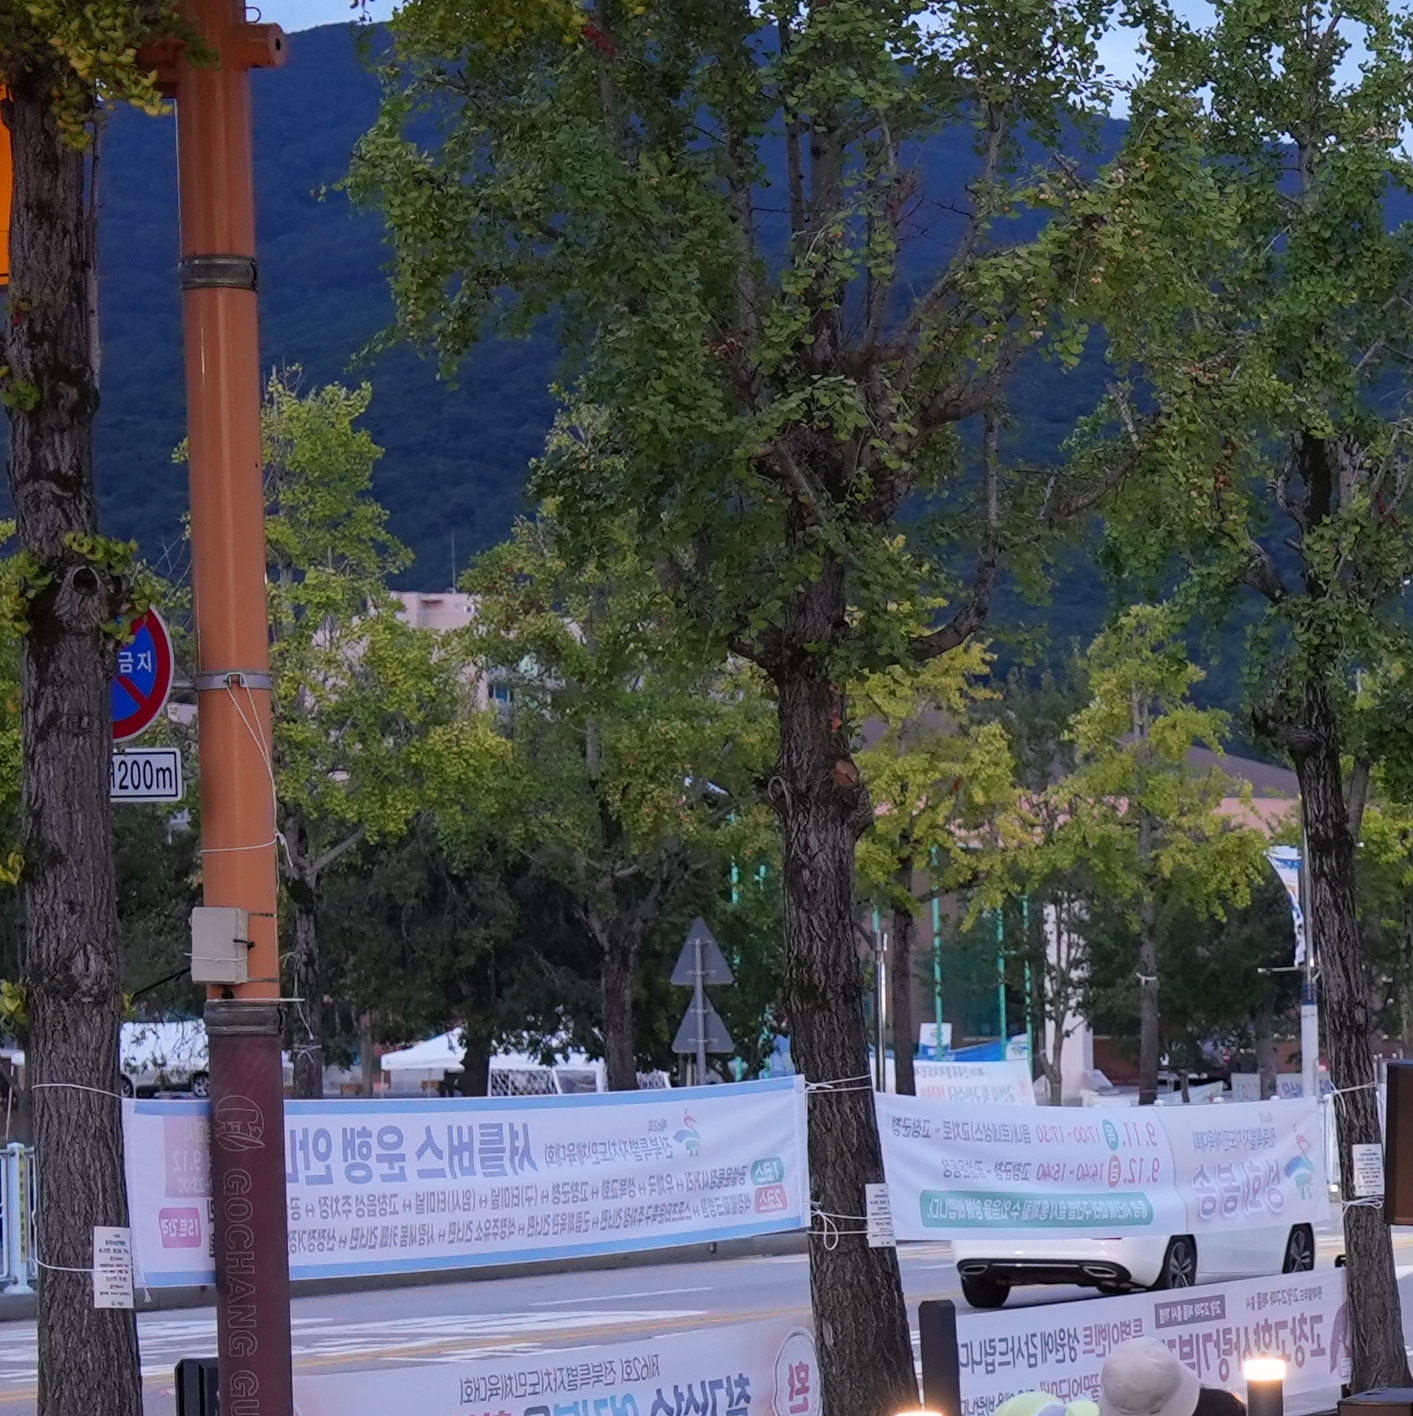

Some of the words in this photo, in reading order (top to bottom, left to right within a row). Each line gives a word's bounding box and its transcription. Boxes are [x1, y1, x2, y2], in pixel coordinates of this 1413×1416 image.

[118, 651, 152, 674] 금지
[112, 759, 173, 791] 200m
[223, 1168, 255, 1358] GOCHANG
